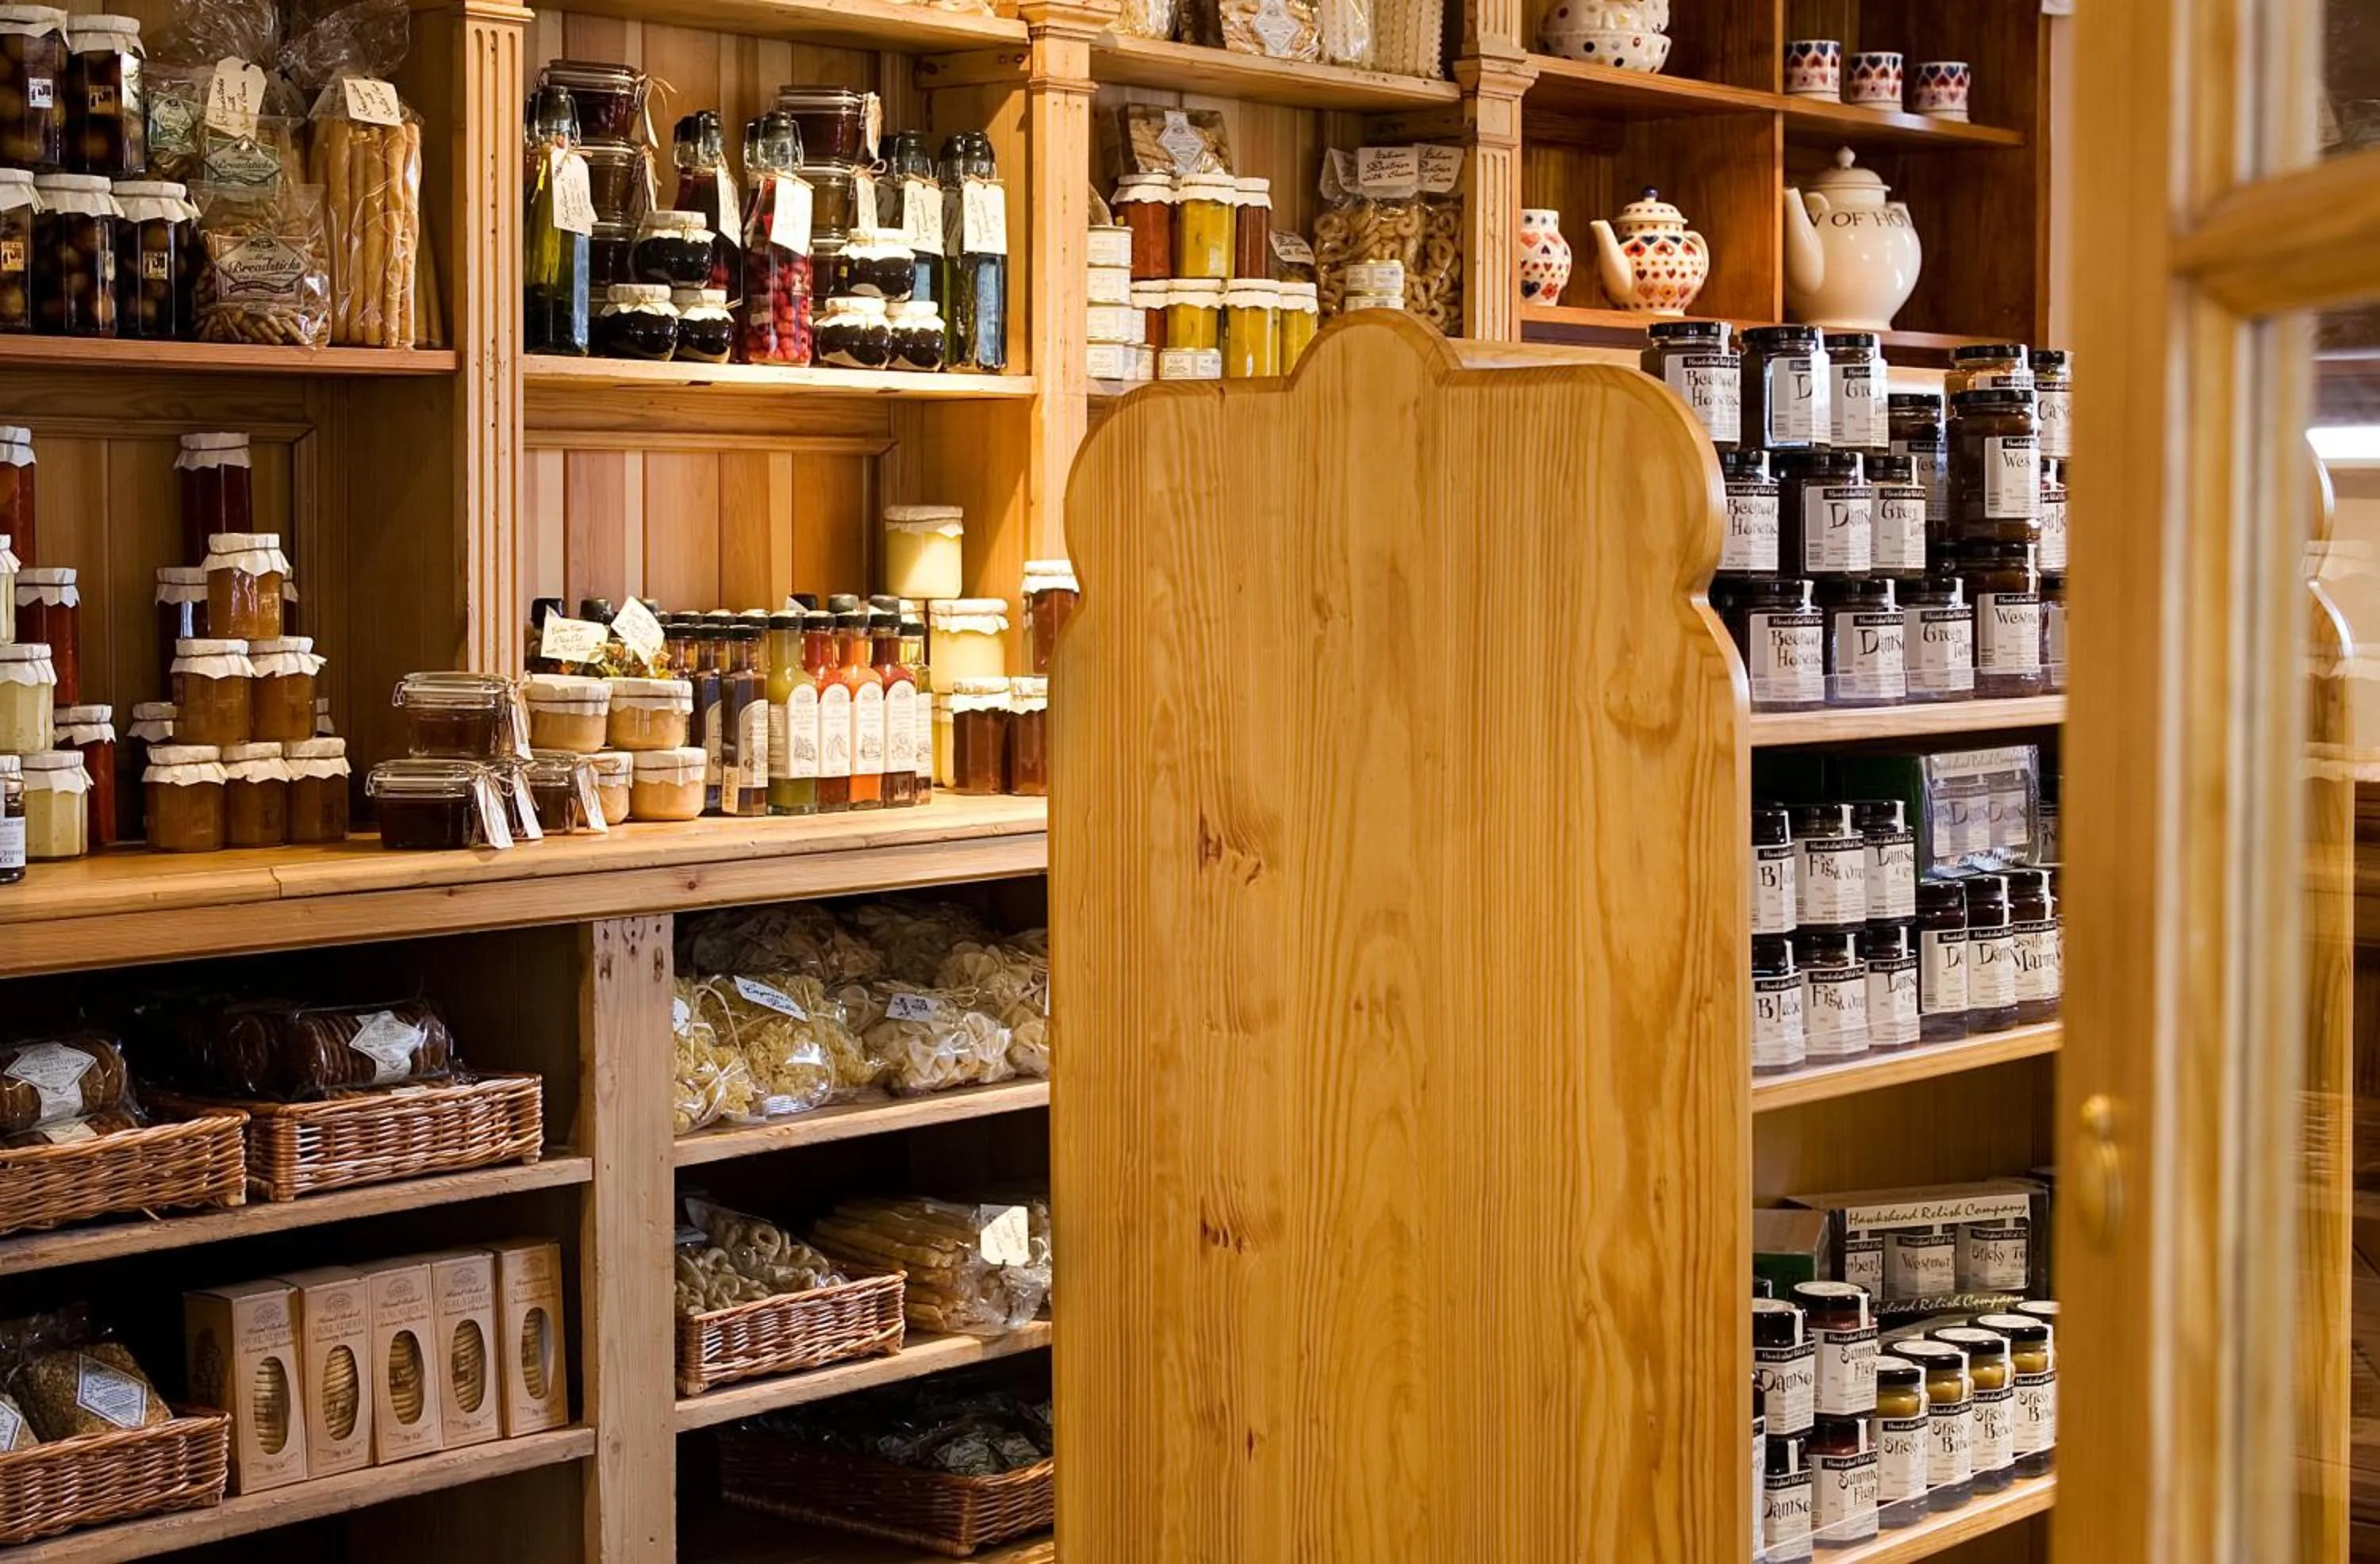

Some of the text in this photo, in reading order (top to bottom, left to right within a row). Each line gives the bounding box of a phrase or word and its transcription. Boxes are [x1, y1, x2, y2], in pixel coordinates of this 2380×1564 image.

[1831, 212, 1866, 227] OF
[1809, 853, 1836, 878] Fig
[1813, 984, 1840, 1008] Fig
[1848, 1202, 2027, 1226] Hawkshead Relish Company
[1919, 1296, 1961, 1310] Relish
[1963, 1293, 2024, 1308] Company
